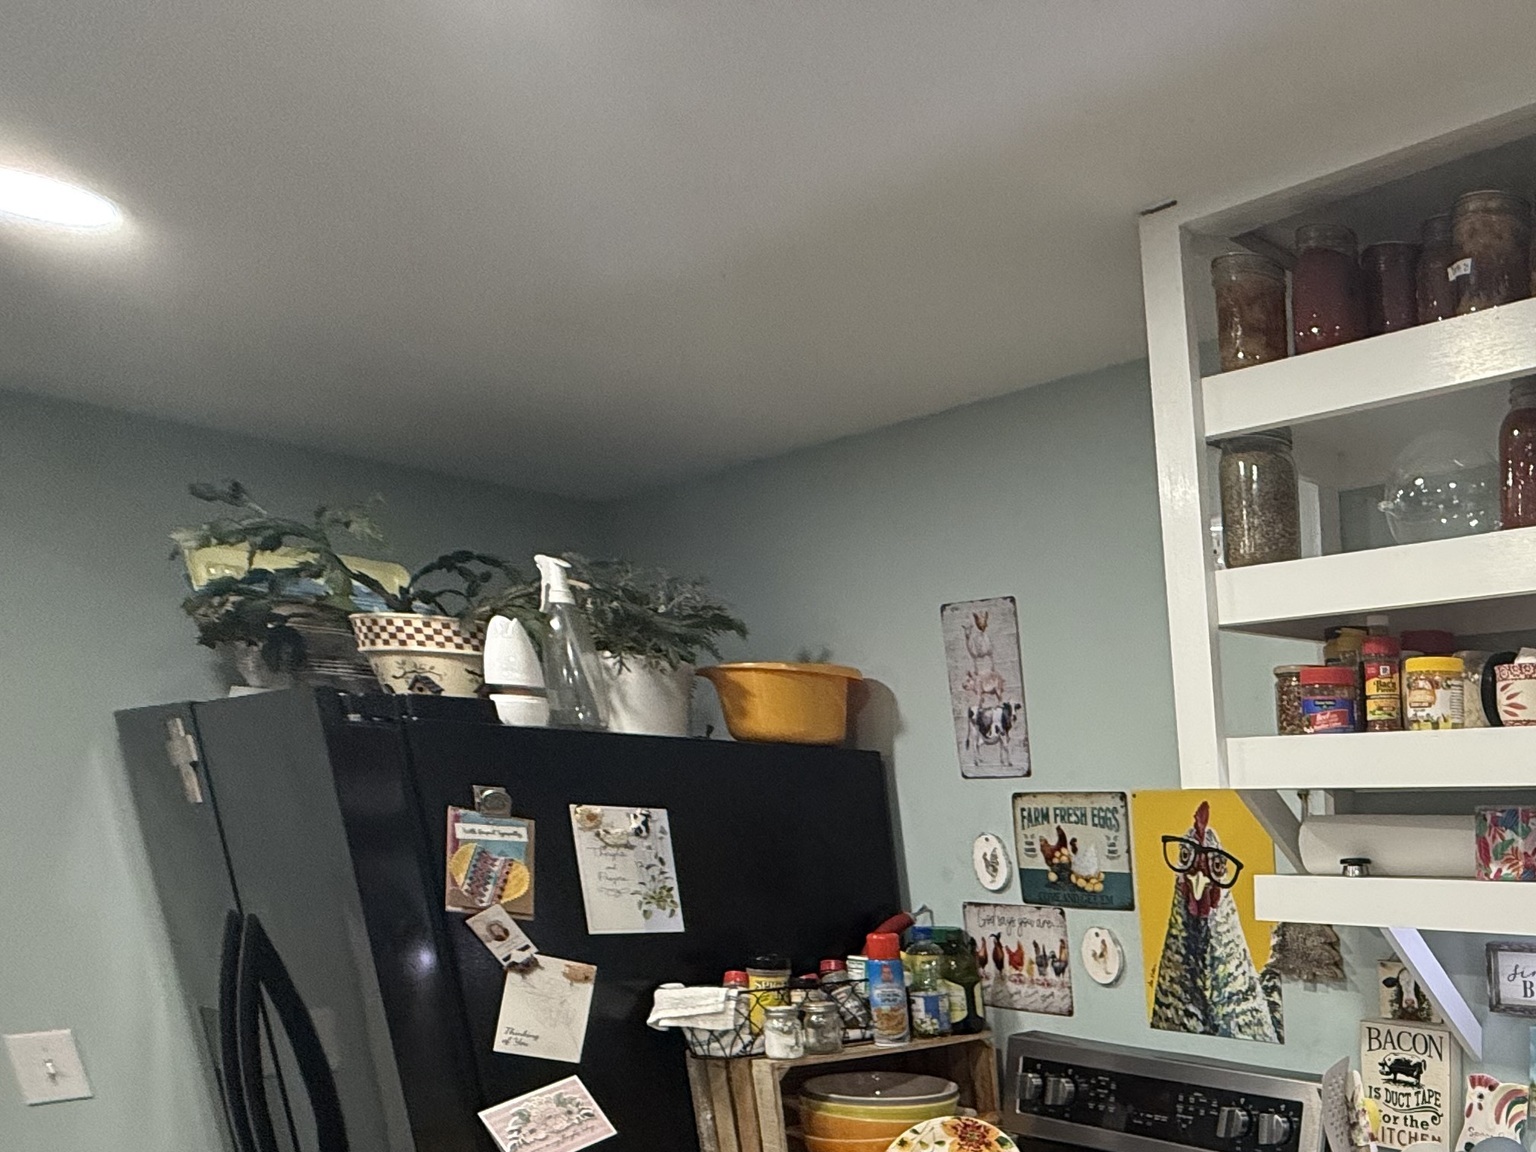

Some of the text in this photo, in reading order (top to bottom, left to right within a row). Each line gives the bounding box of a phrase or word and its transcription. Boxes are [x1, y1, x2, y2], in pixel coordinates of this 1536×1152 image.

[1020, 806, 1120, 833] FARM FRESH EGGS
[1366, 1026, 1444, 1062] BACON
[1368, 1085, 1442, 1109] IS DUCT TAPE
[1403, 1113, 1431, 1131] the
